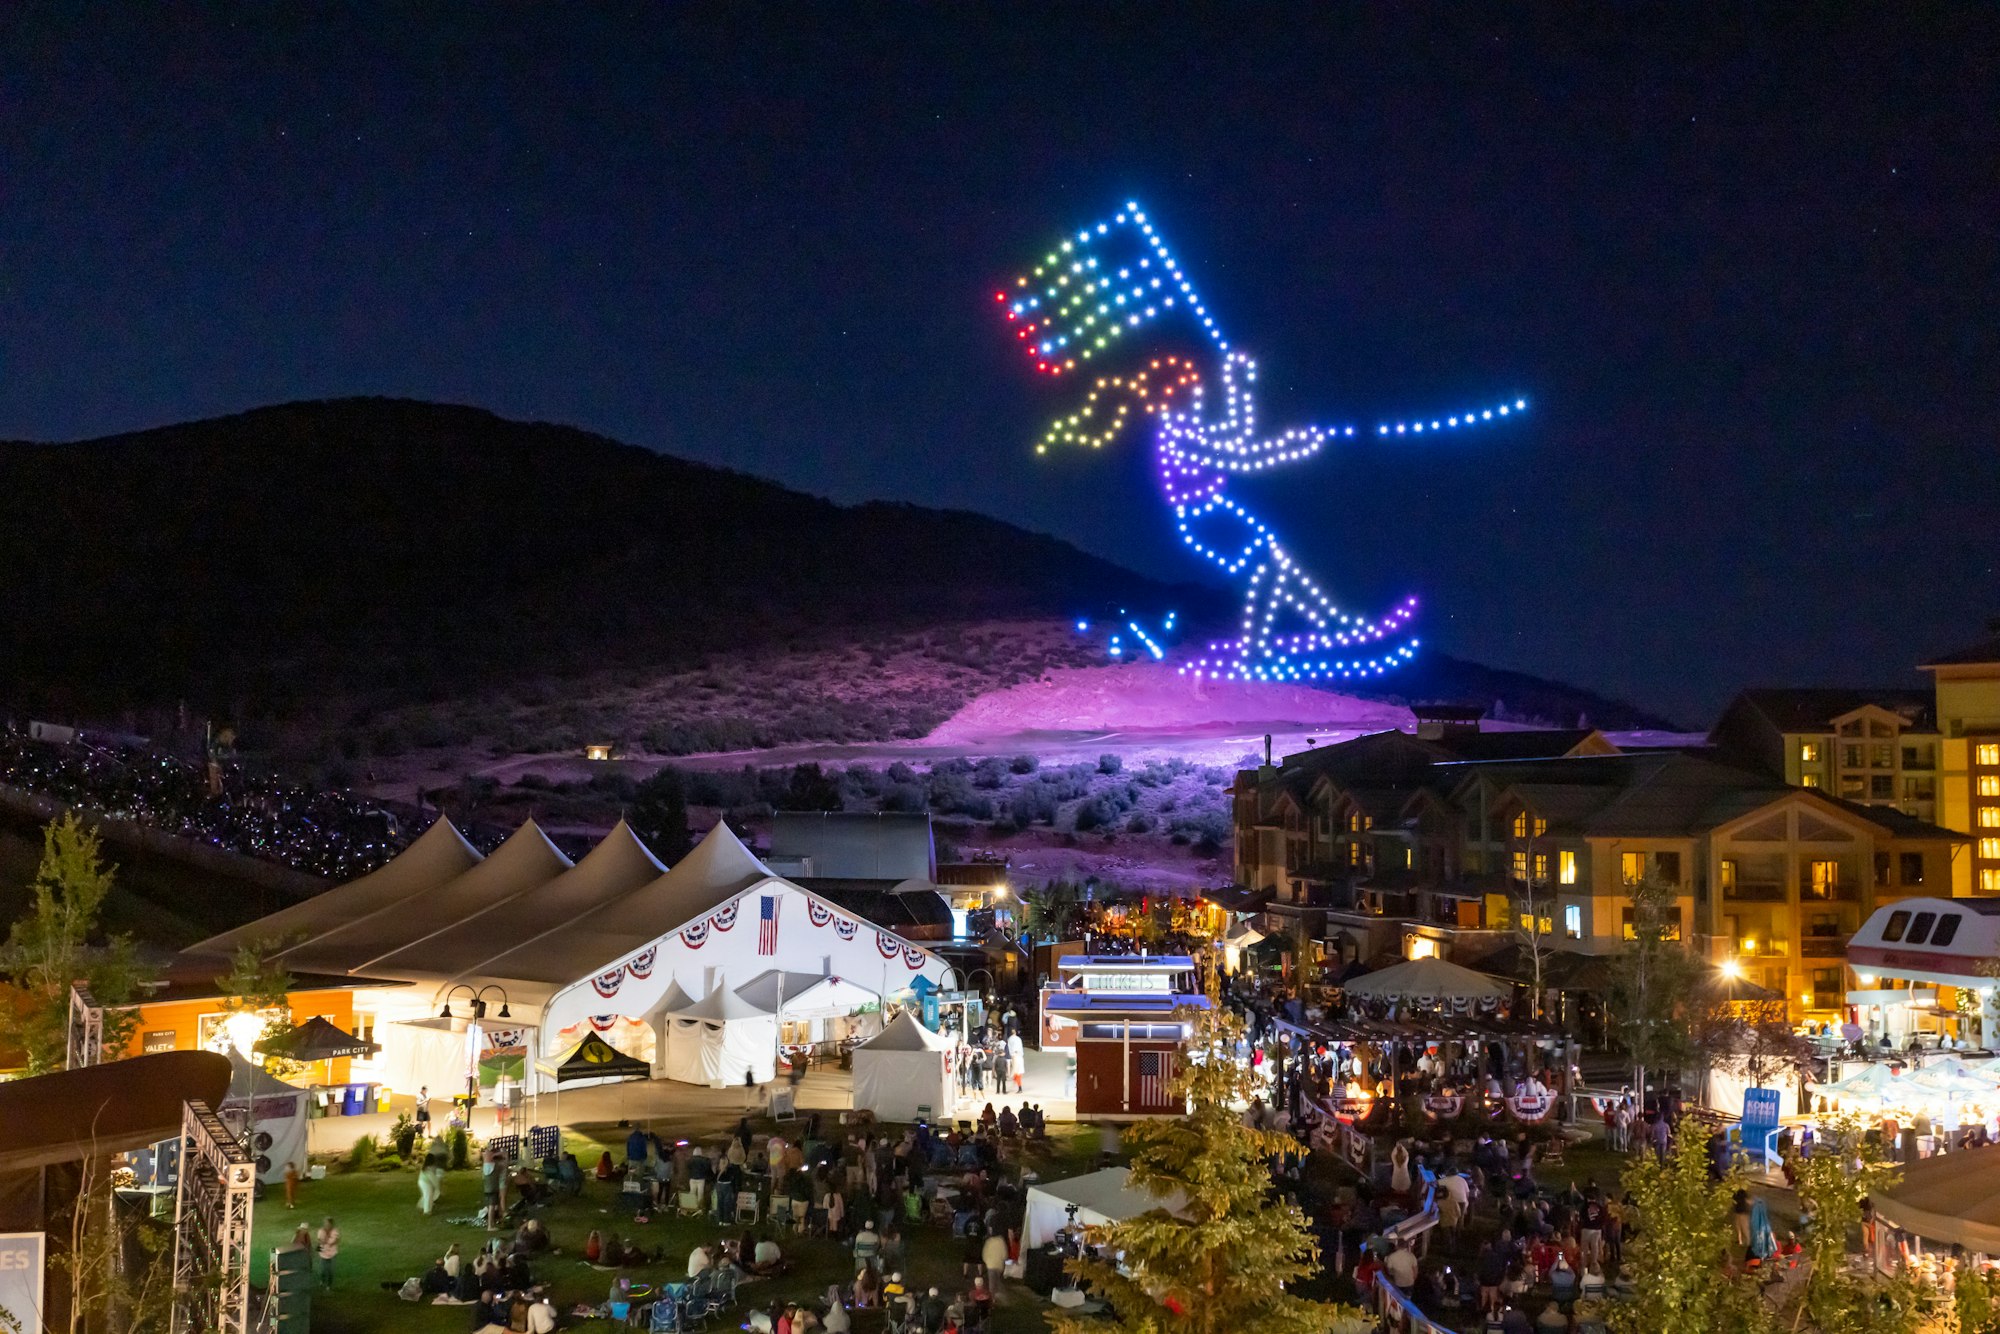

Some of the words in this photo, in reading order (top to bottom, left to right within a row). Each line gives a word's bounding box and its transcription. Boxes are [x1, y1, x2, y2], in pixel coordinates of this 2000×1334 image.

[1096, 974, 1153, 990] TICKETS
[145, 1043, 167, 1052] VALET
[332, 1048, 351, 1056] PARK
[352, 1046, 369, 1054] CITY
[1746, 1100, 1776, 1111] KONA
